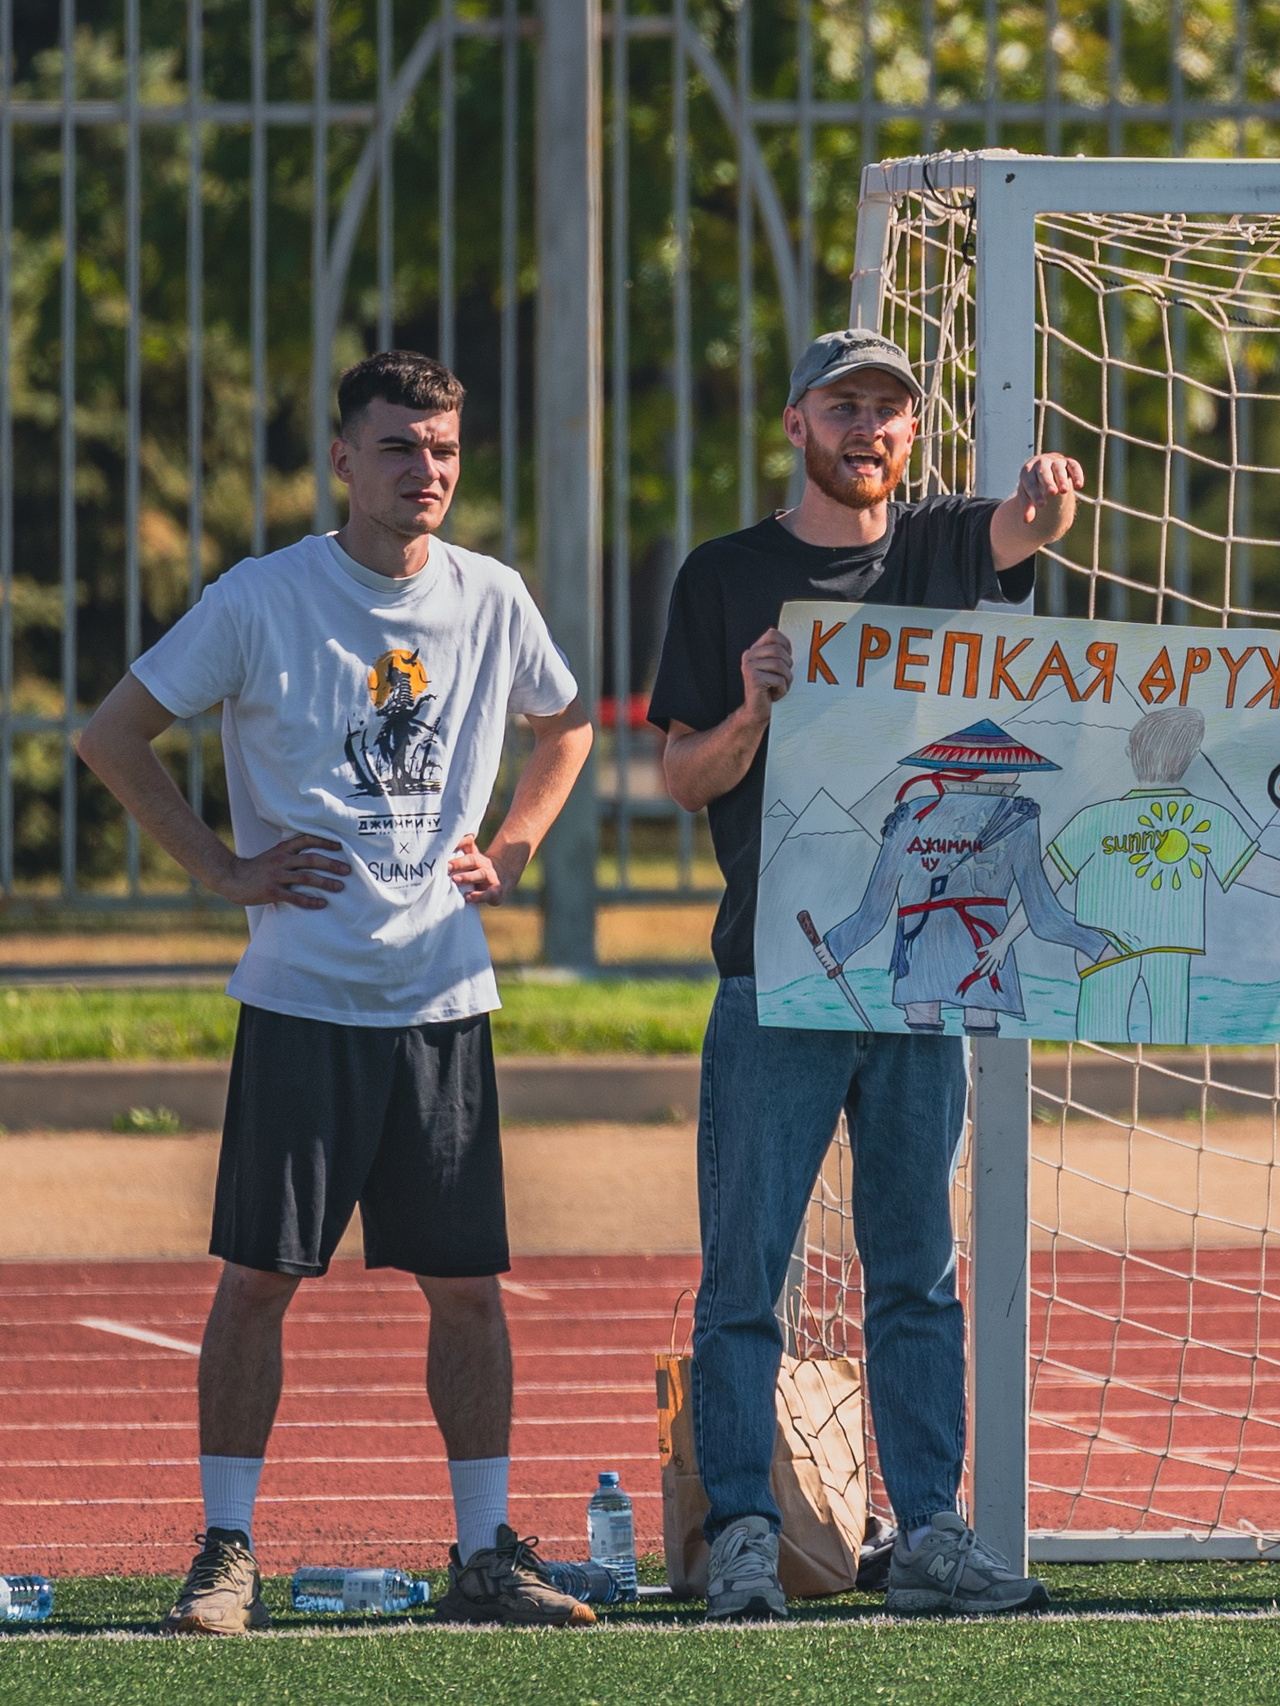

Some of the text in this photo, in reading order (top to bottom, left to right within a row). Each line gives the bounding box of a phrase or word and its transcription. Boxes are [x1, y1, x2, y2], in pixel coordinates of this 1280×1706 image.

[807, 620, 1118, 703] КРЕПКАЯ
[1102, 829, 1169, 855] sunny
[368, 858, 437, 883] SUNNY
